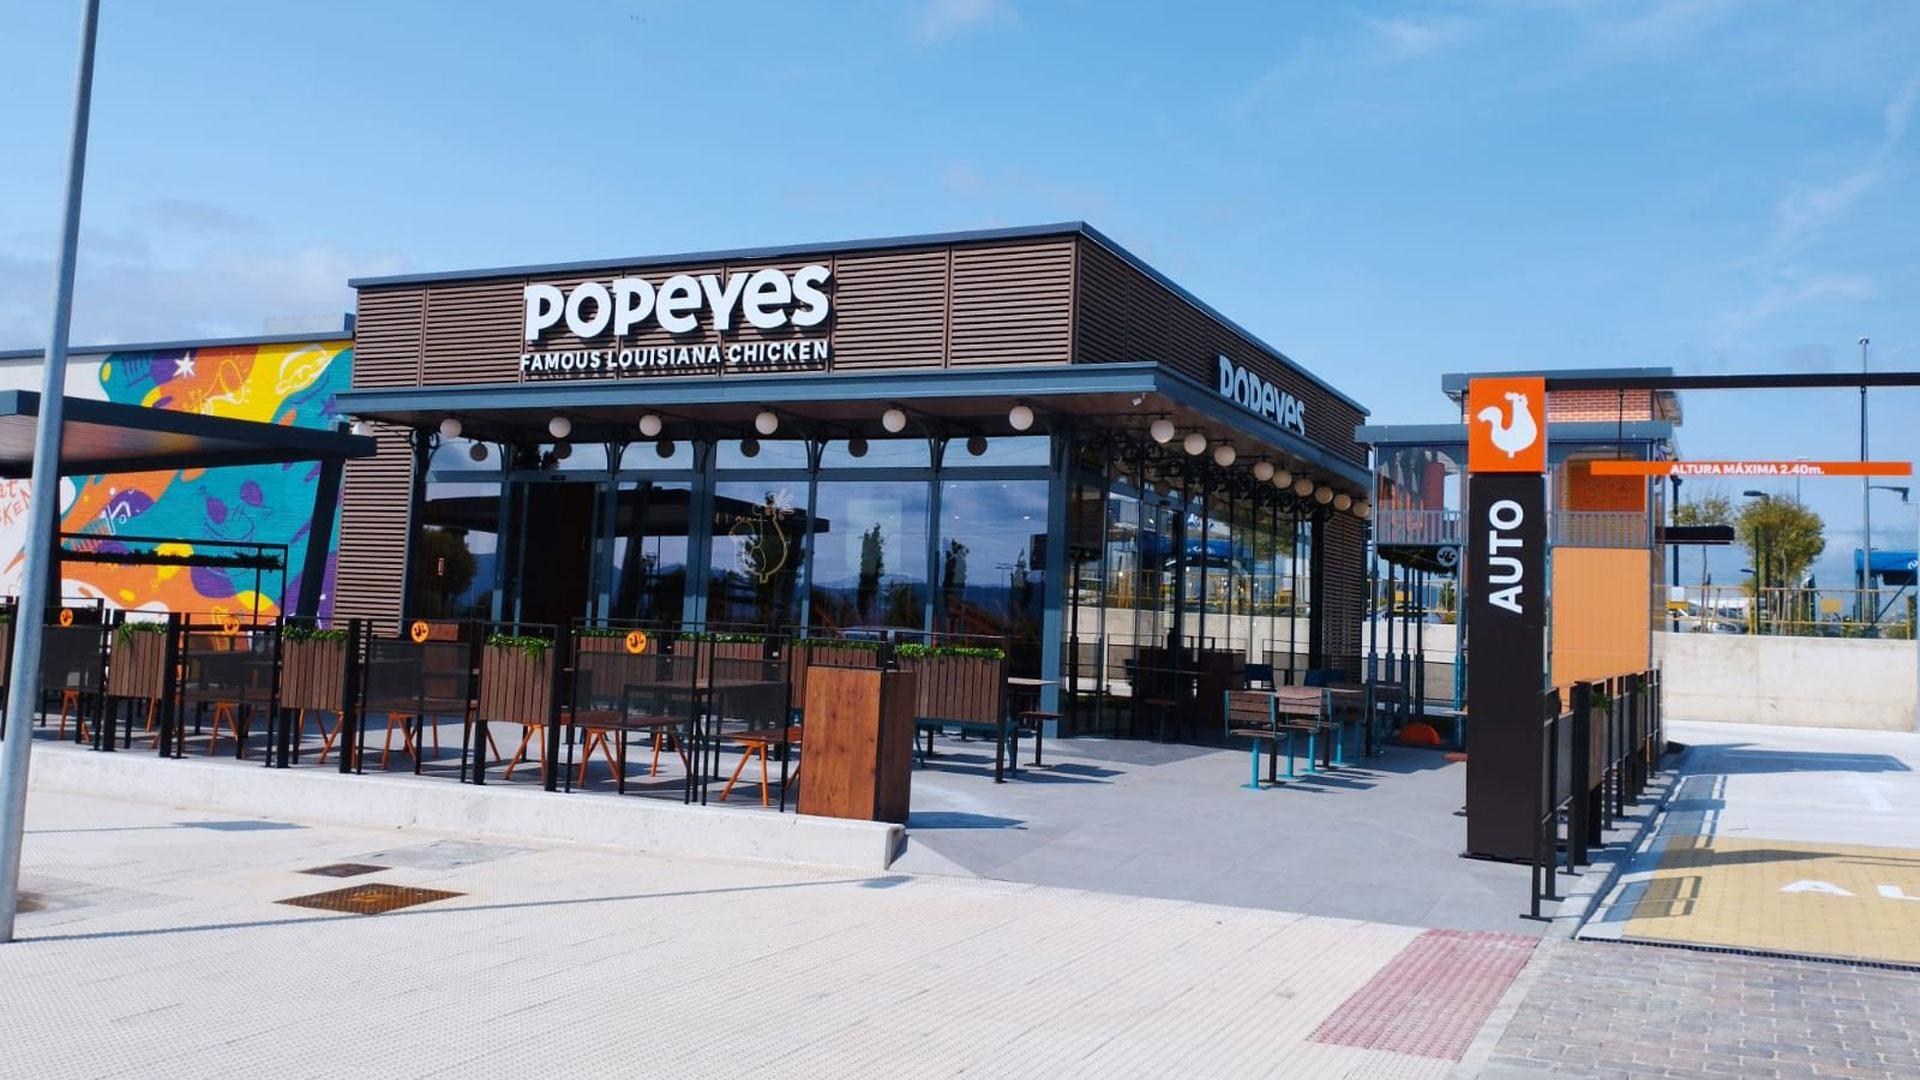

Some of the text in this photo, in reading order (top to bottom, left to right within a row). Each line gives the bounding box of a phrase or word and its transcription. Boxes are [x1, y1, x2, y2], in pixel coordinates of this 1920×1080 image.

[520, 341, 829, 372] FAMOUS LOUISIANA CHICKEN
[1670, 462, 1825, 475] ALTURA MÁXIMA 2.40m.
[1488, 499, 1524, 614] AUTO
